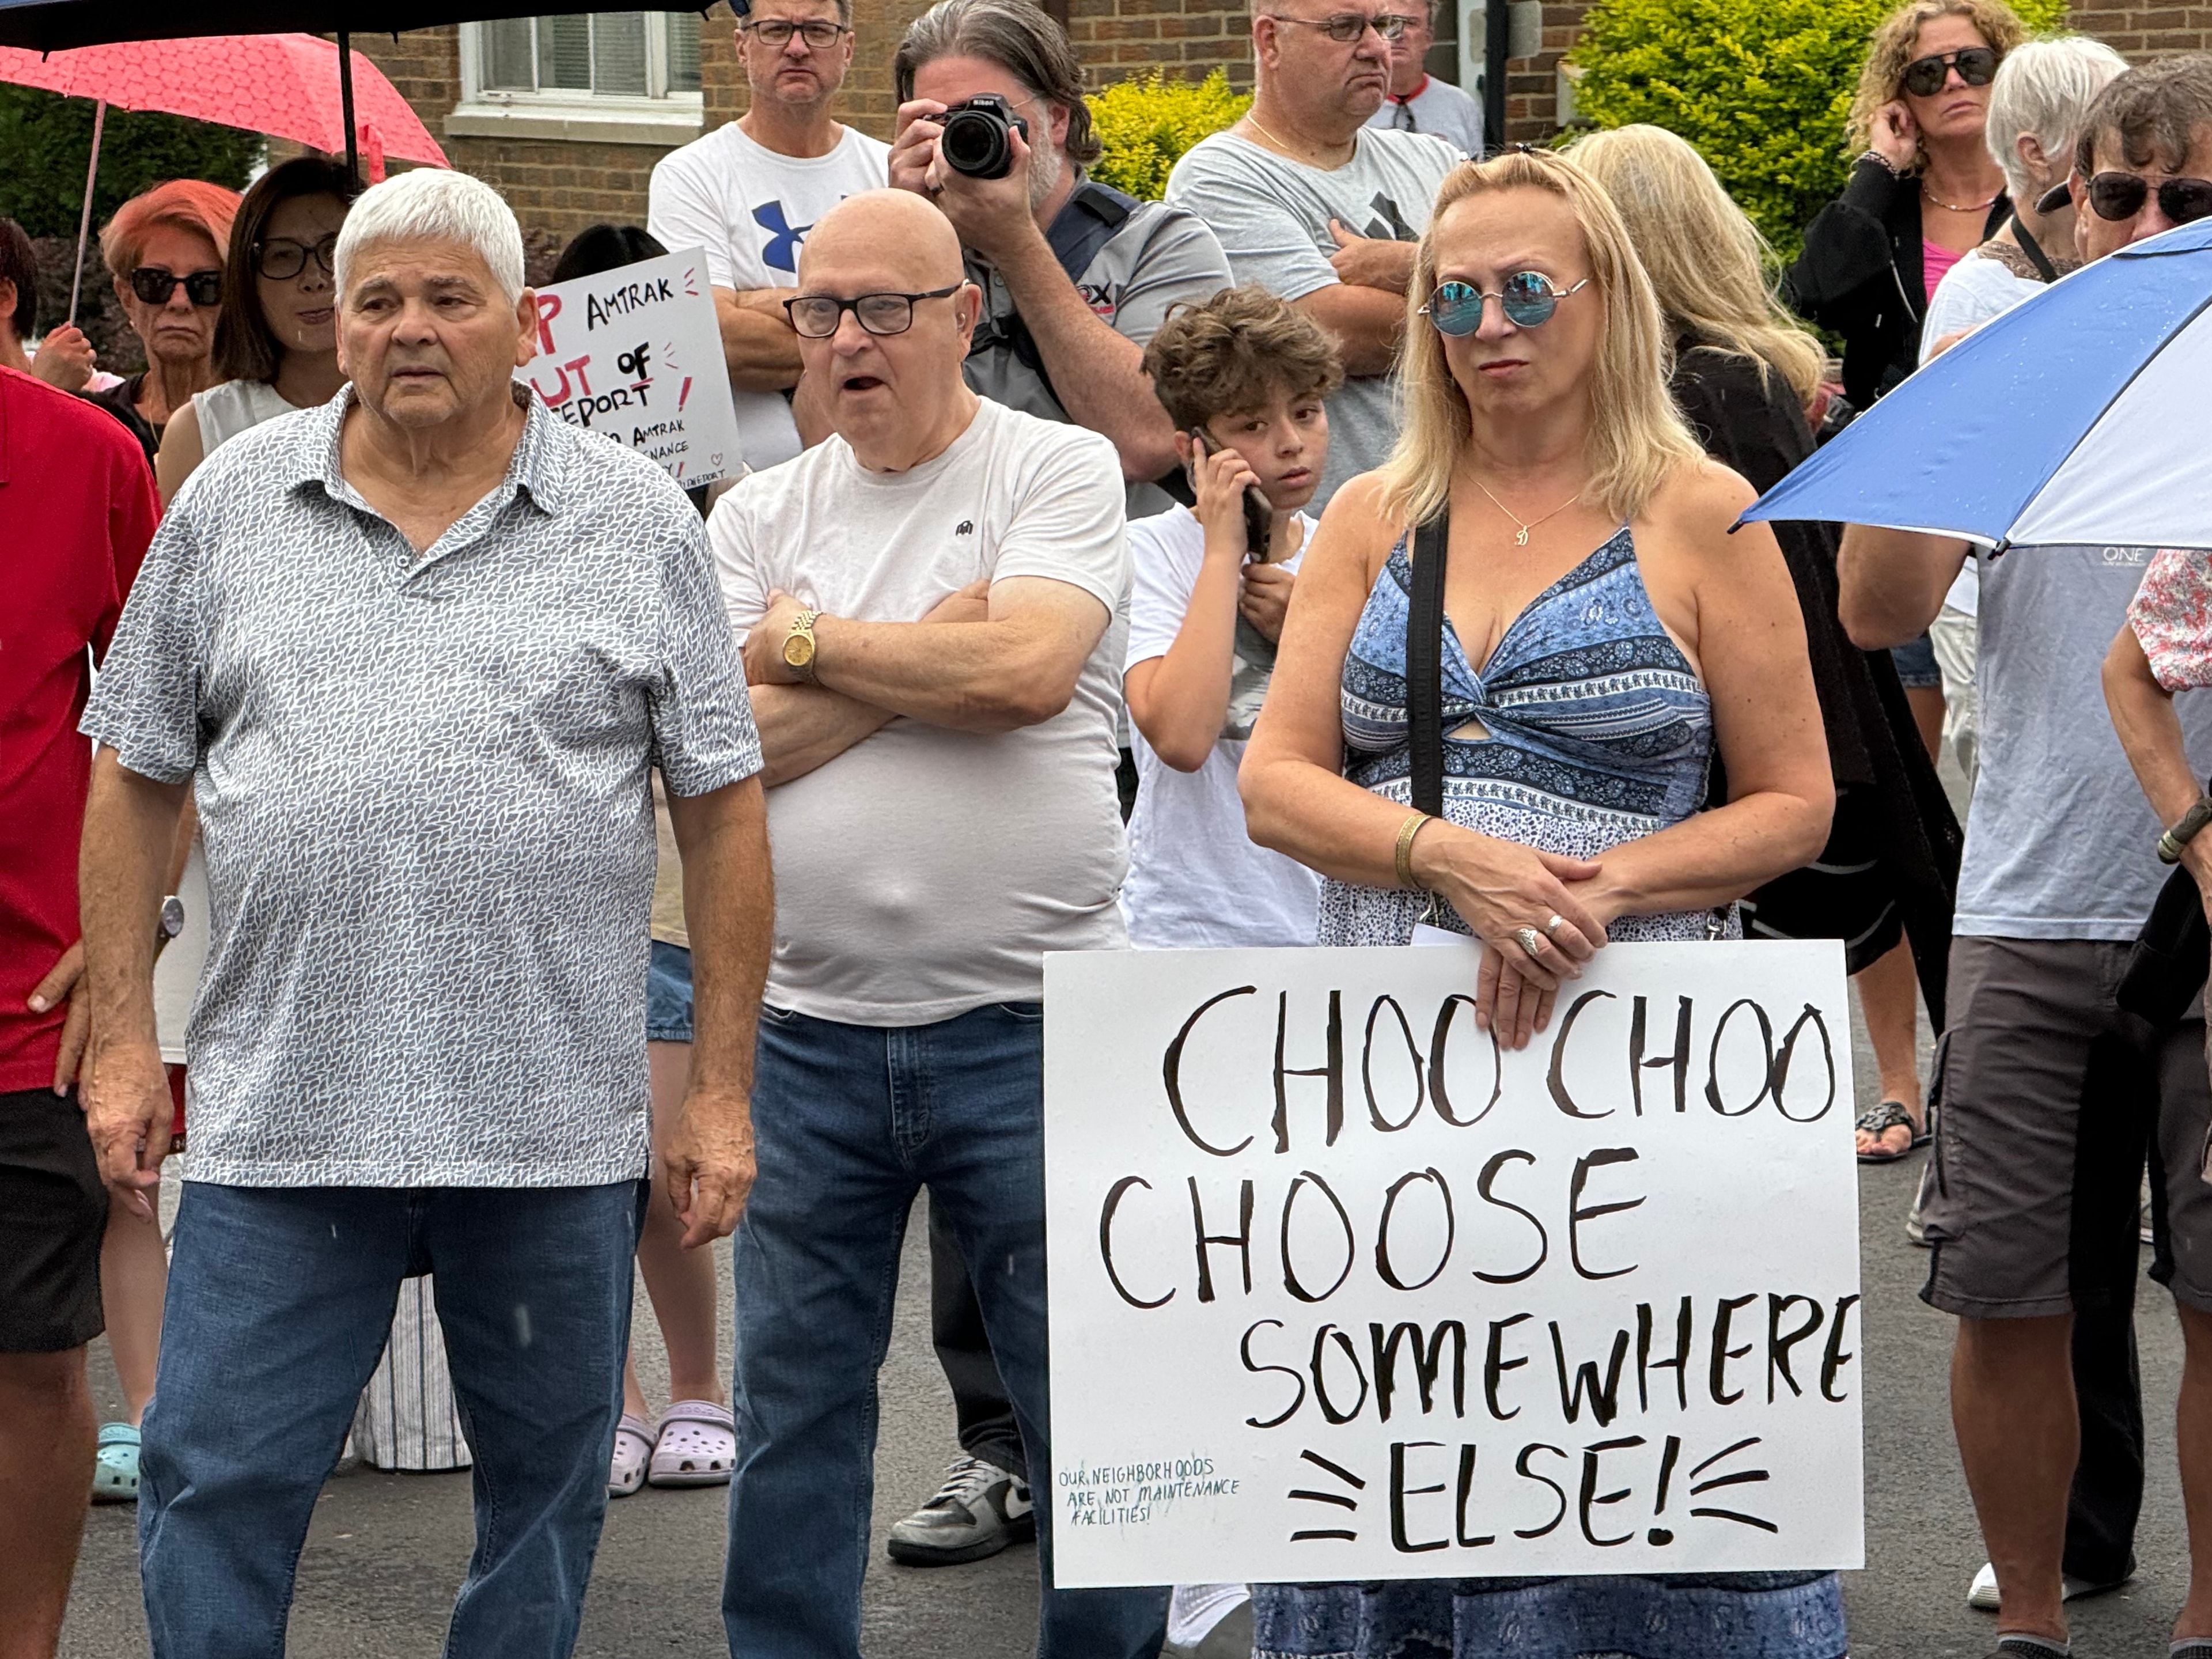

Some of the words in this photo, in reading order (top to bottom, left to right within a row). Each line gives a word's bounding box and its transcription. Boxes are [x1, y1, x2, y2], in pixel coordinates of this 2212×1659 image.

[587, 278, 674, 332] AMTRAK
[529, 354, 592, 408] UT
[617, 341, 651, 381] OF
[550, 384, 651, 428] EPORT
[633, 419, 685, 447] AMTRAK
[2103, 546, 2145, 562] ONE
[1163, 985, 1502, 1157] CHOO
[1546, 989, 1836, 1123] CHOO
[1100, 1147, 1646, 1309] CHOOSE
[1240, 1293, 1860, 1429] SOMEWHERE
[1066, 1491, 1095, 1507] ARE
[1105, 1489, 1130, 1505] NOT
[1138, 1479, 1240, 1502] MAINTENANCE
[1092, 1458, 1214, 1485] NEIGHBORHOODS
[1389, 1435, 1681, 1553] ELSE!
[1071, 1506, 1151, 1526] FACILITIES!
